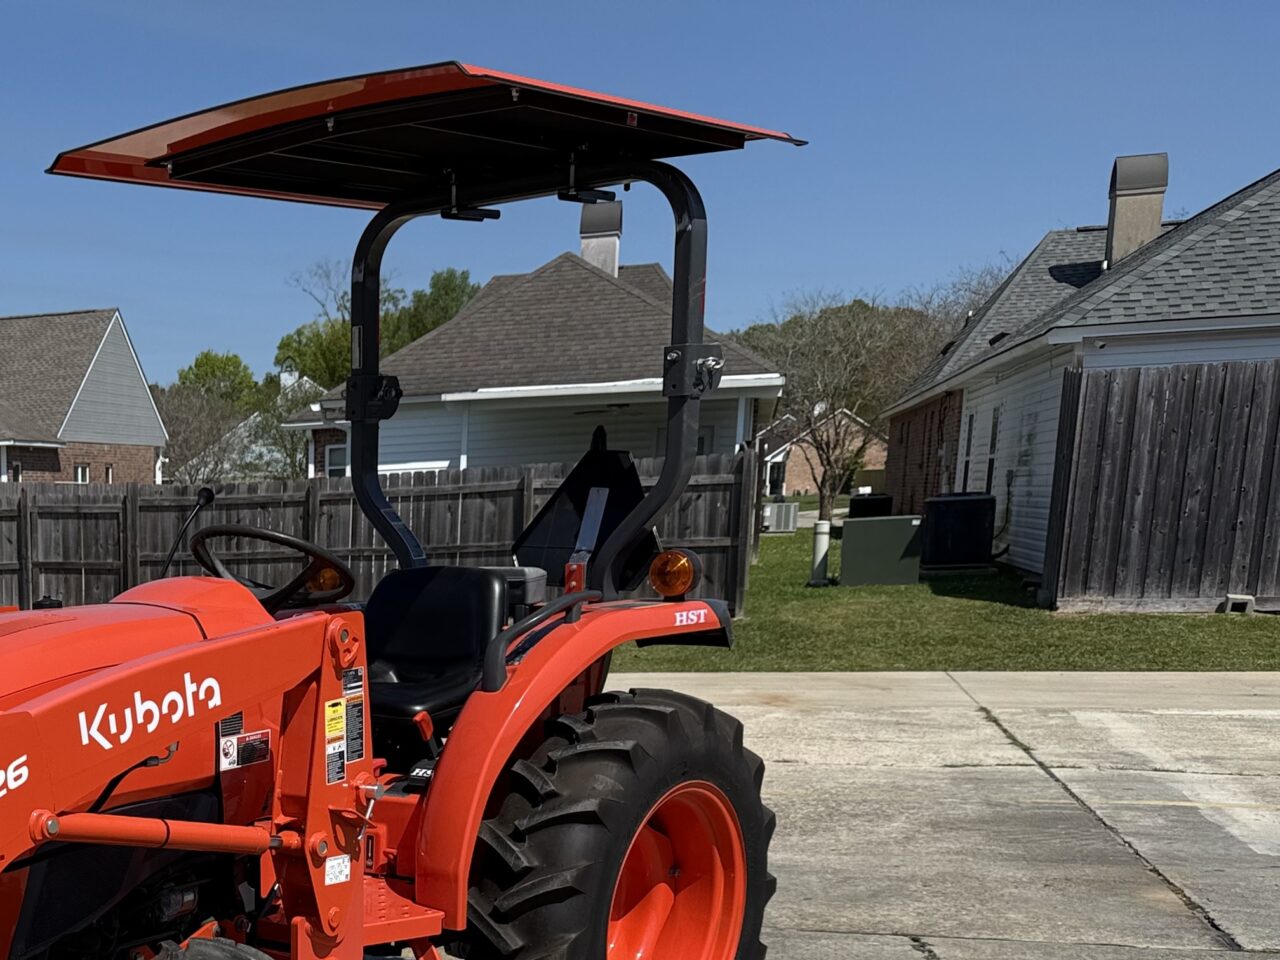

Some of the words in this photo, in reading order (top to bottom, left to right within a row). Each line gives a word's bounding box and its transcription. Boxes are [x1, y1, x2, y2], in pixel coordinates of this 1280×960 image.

[674, 608, 708, 627] HST
[78, 672, 222, 750] Kubota
[410, 767, 433, 778] HS
